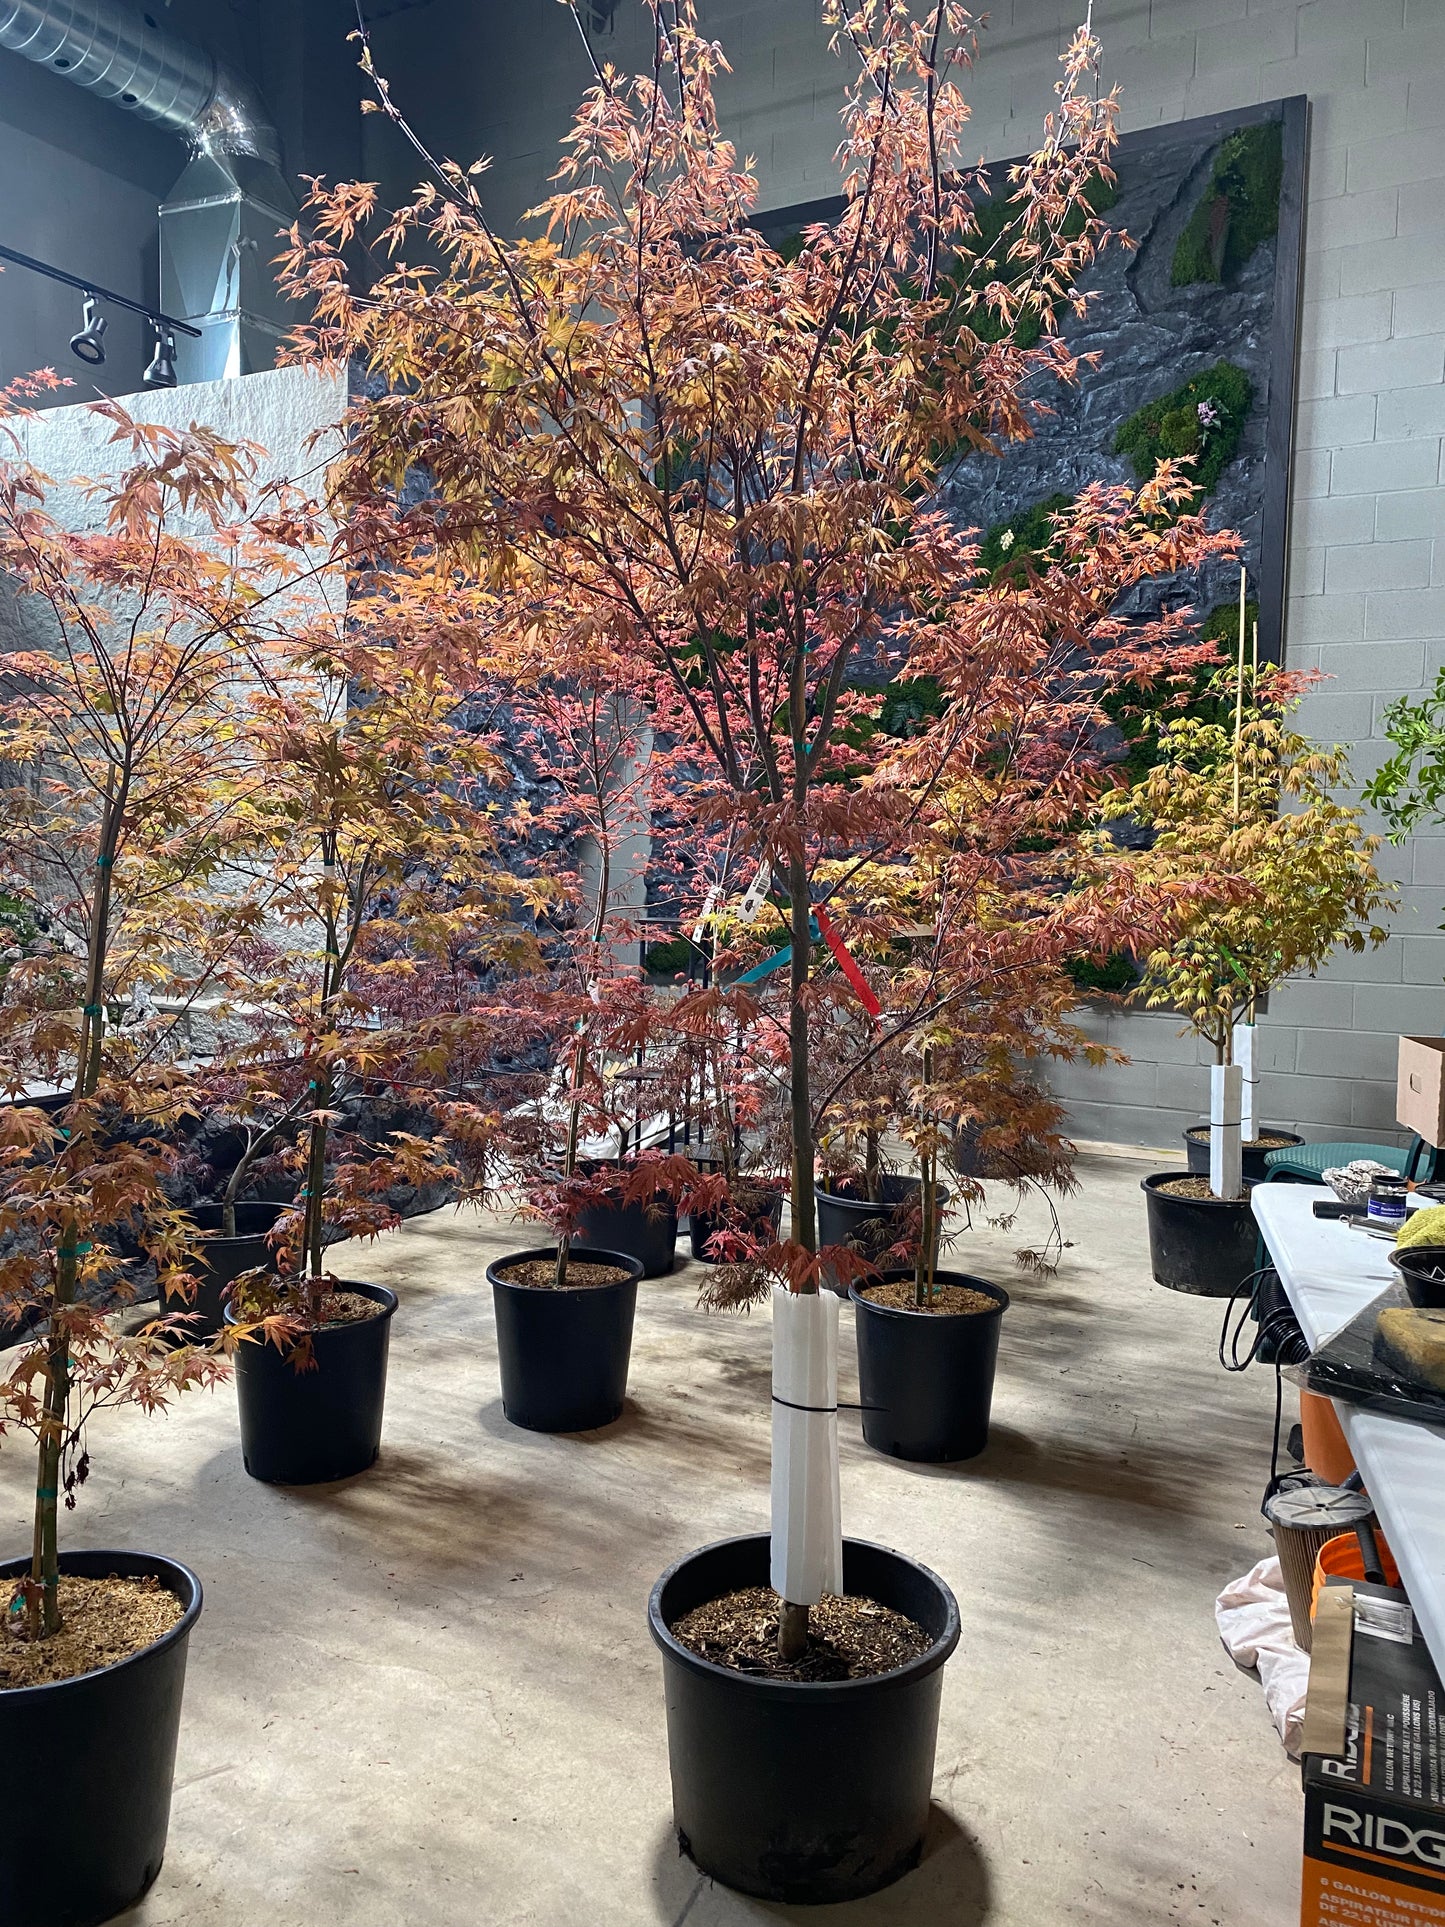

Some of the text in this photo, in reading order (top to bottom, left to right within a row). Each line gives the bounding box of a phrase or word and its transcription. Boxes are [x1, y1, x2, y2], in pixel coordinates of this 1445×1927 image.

[1412, 1711, 1421, 1743] GALLONS
[1385, 1760, 1394, 1786] GALLON
[1333, 1881, 1391, 1904] GALLON
[1319, 1901, 1338, 1914] DE
[1320, 1892, 1410, 1924] ASPIRATEUR
